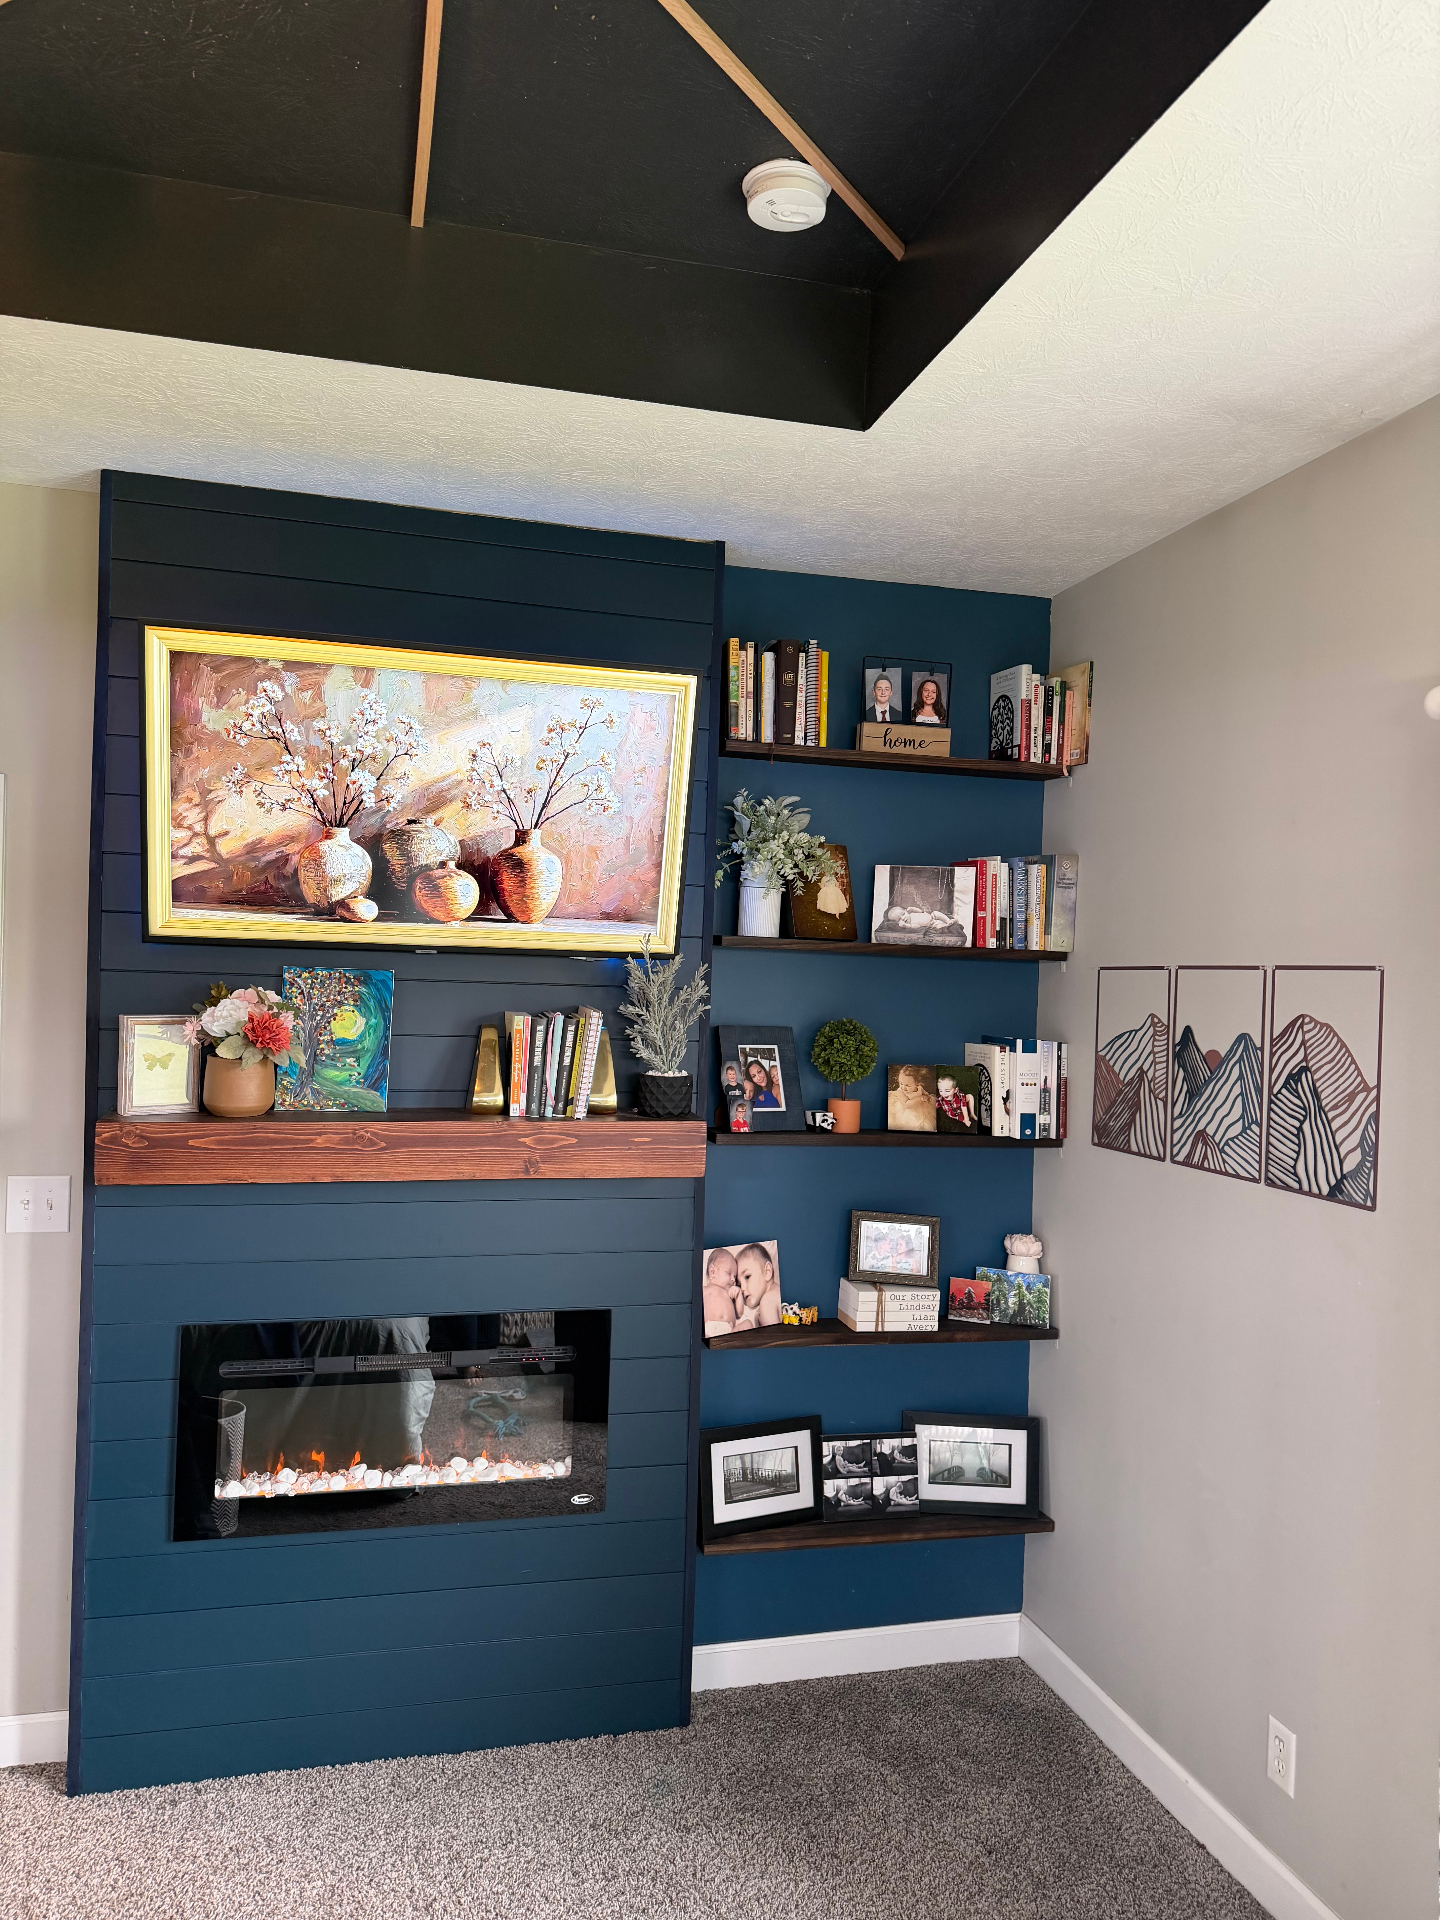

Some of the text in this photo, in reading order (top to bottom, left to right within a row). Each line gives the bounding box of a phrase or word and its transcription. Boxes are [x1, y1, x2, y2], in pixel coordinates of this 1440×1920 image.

[881, 727, 935, 750] home
[890, 1293, 938, 1301] Our Story
[899, 1303, 937, 1311] Lindsay
[906, 1323, 936, 1331] Avery
